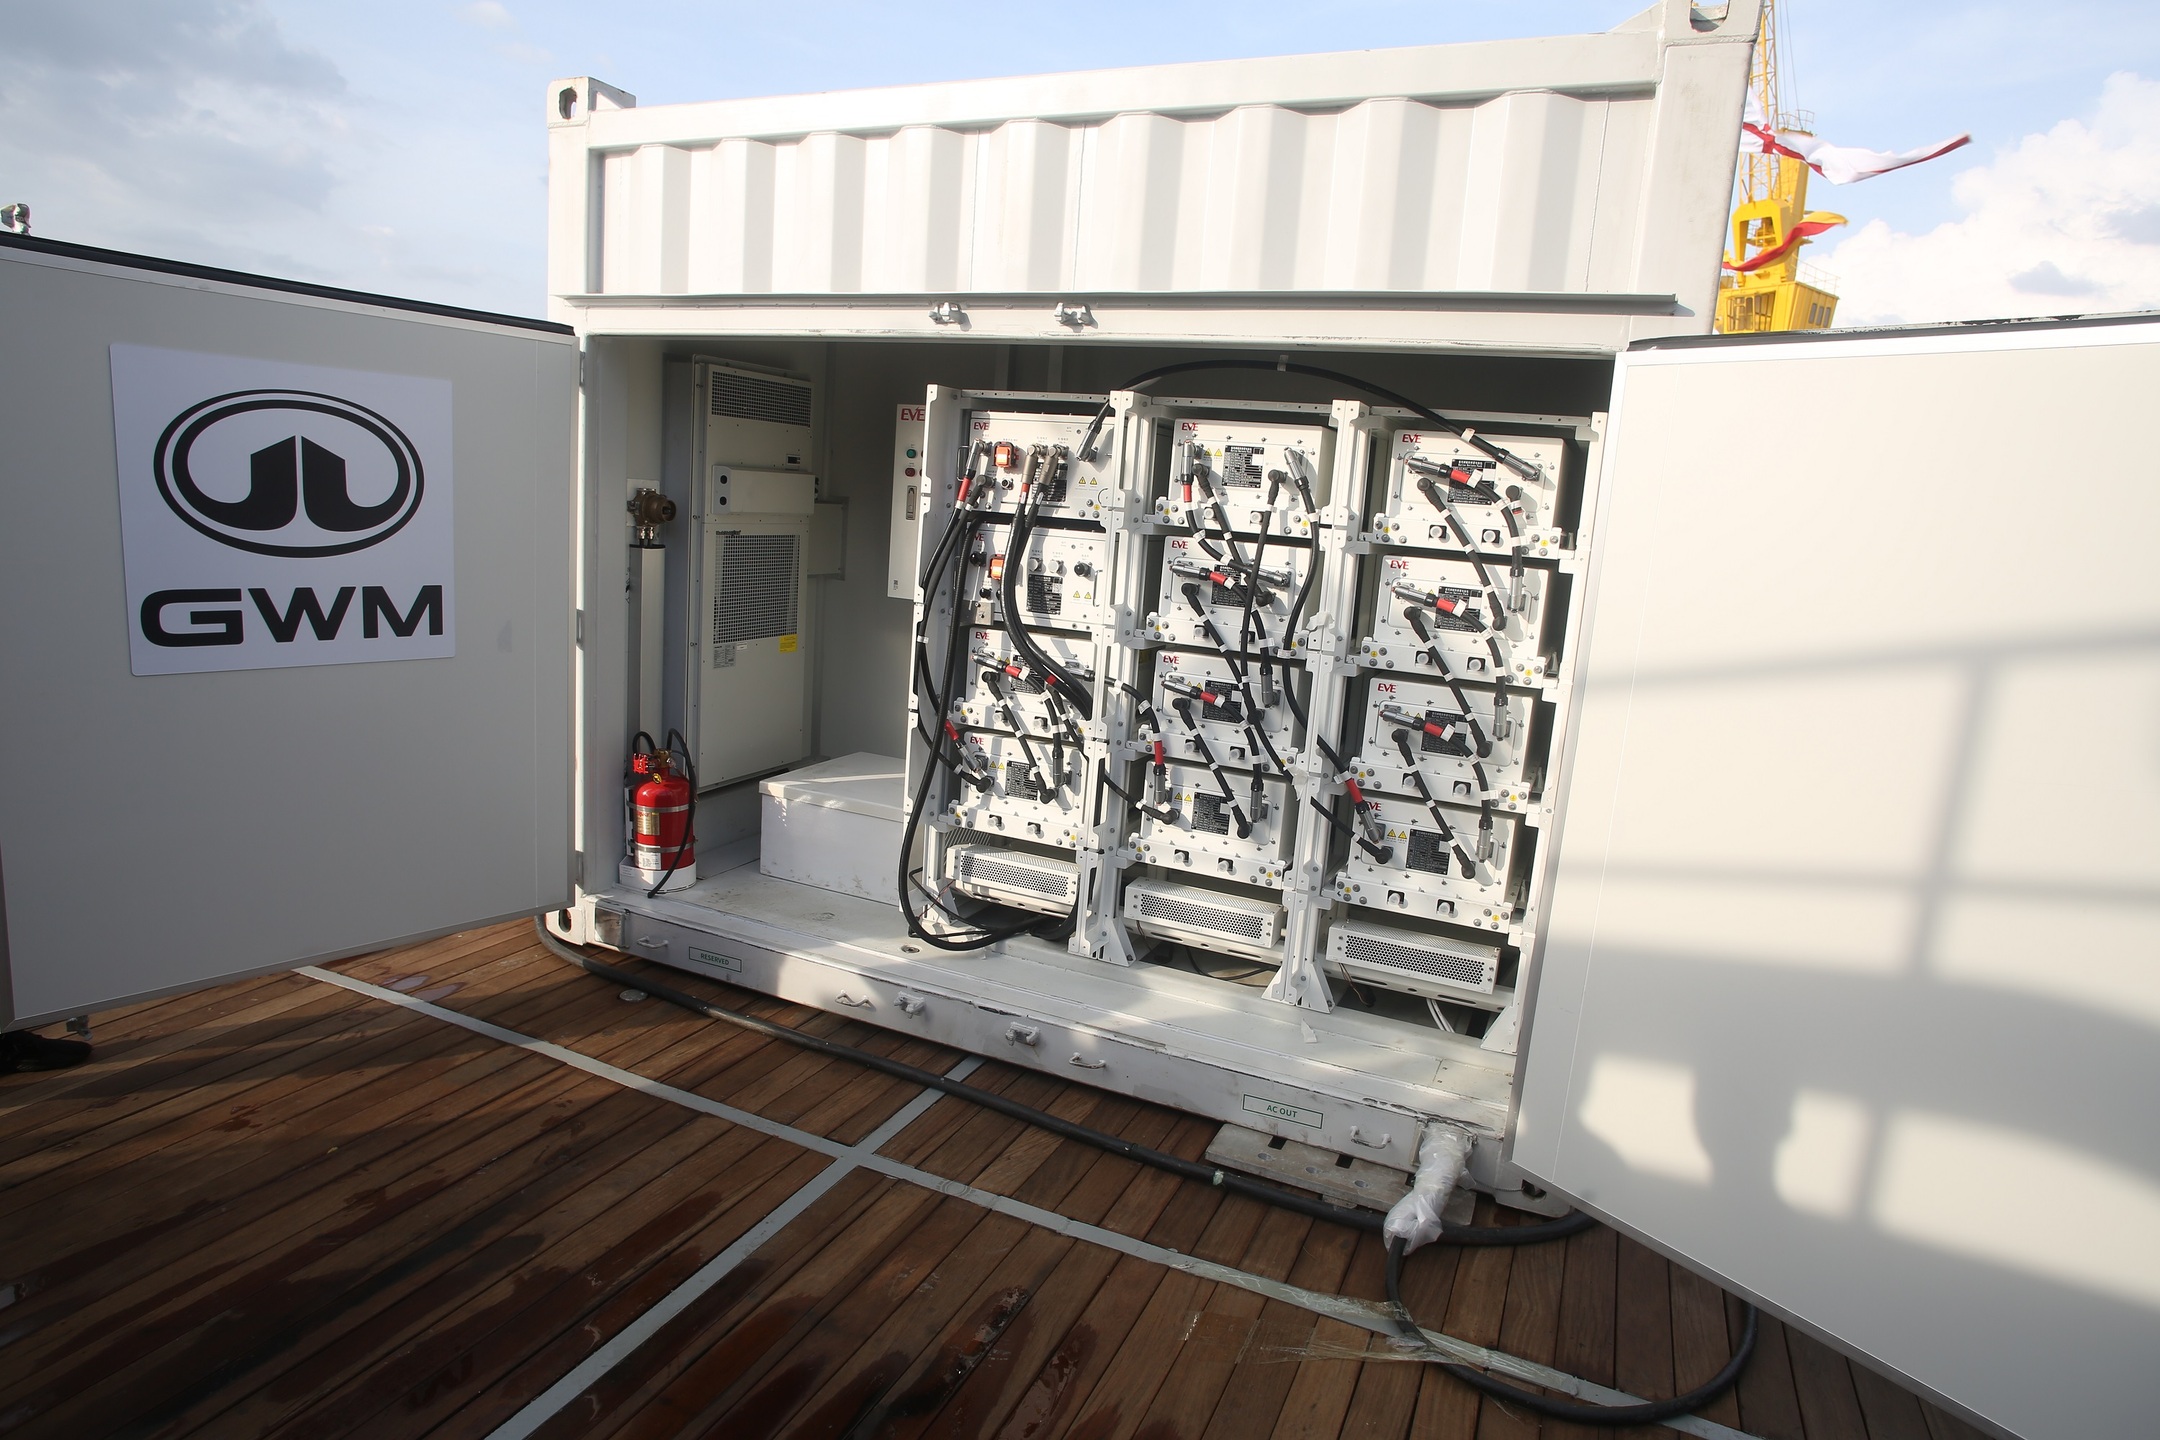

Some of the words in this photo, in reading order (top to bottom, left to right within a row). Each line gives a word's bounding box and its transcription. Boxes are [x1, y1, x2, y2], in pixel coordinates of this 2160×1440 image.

[901, 407, 925, 421] EVE
[973, 421, 990, 431] EVE
[1181, 422, 1199, 432] EVE
[1402, 433, 1422, 444] EVE
[1171, 540, 1189, 550] EVE
[1390, 559, 1410, 570] EVE
[140, 584, 444, 648] GWM
[975, 631, 990, 641] EVE
[1163, 654, 1180, 665] EVE
[1377, 682, 1397, 694] EVE
[970, 736, 985, 746] EVE
[1368, 801, 1382, 811] VE
[700, 953, 730, 966] RESERVED
[1266, 1104, 1278, 1114] AC
[1279, 1107, 1298, 1118] OUT
